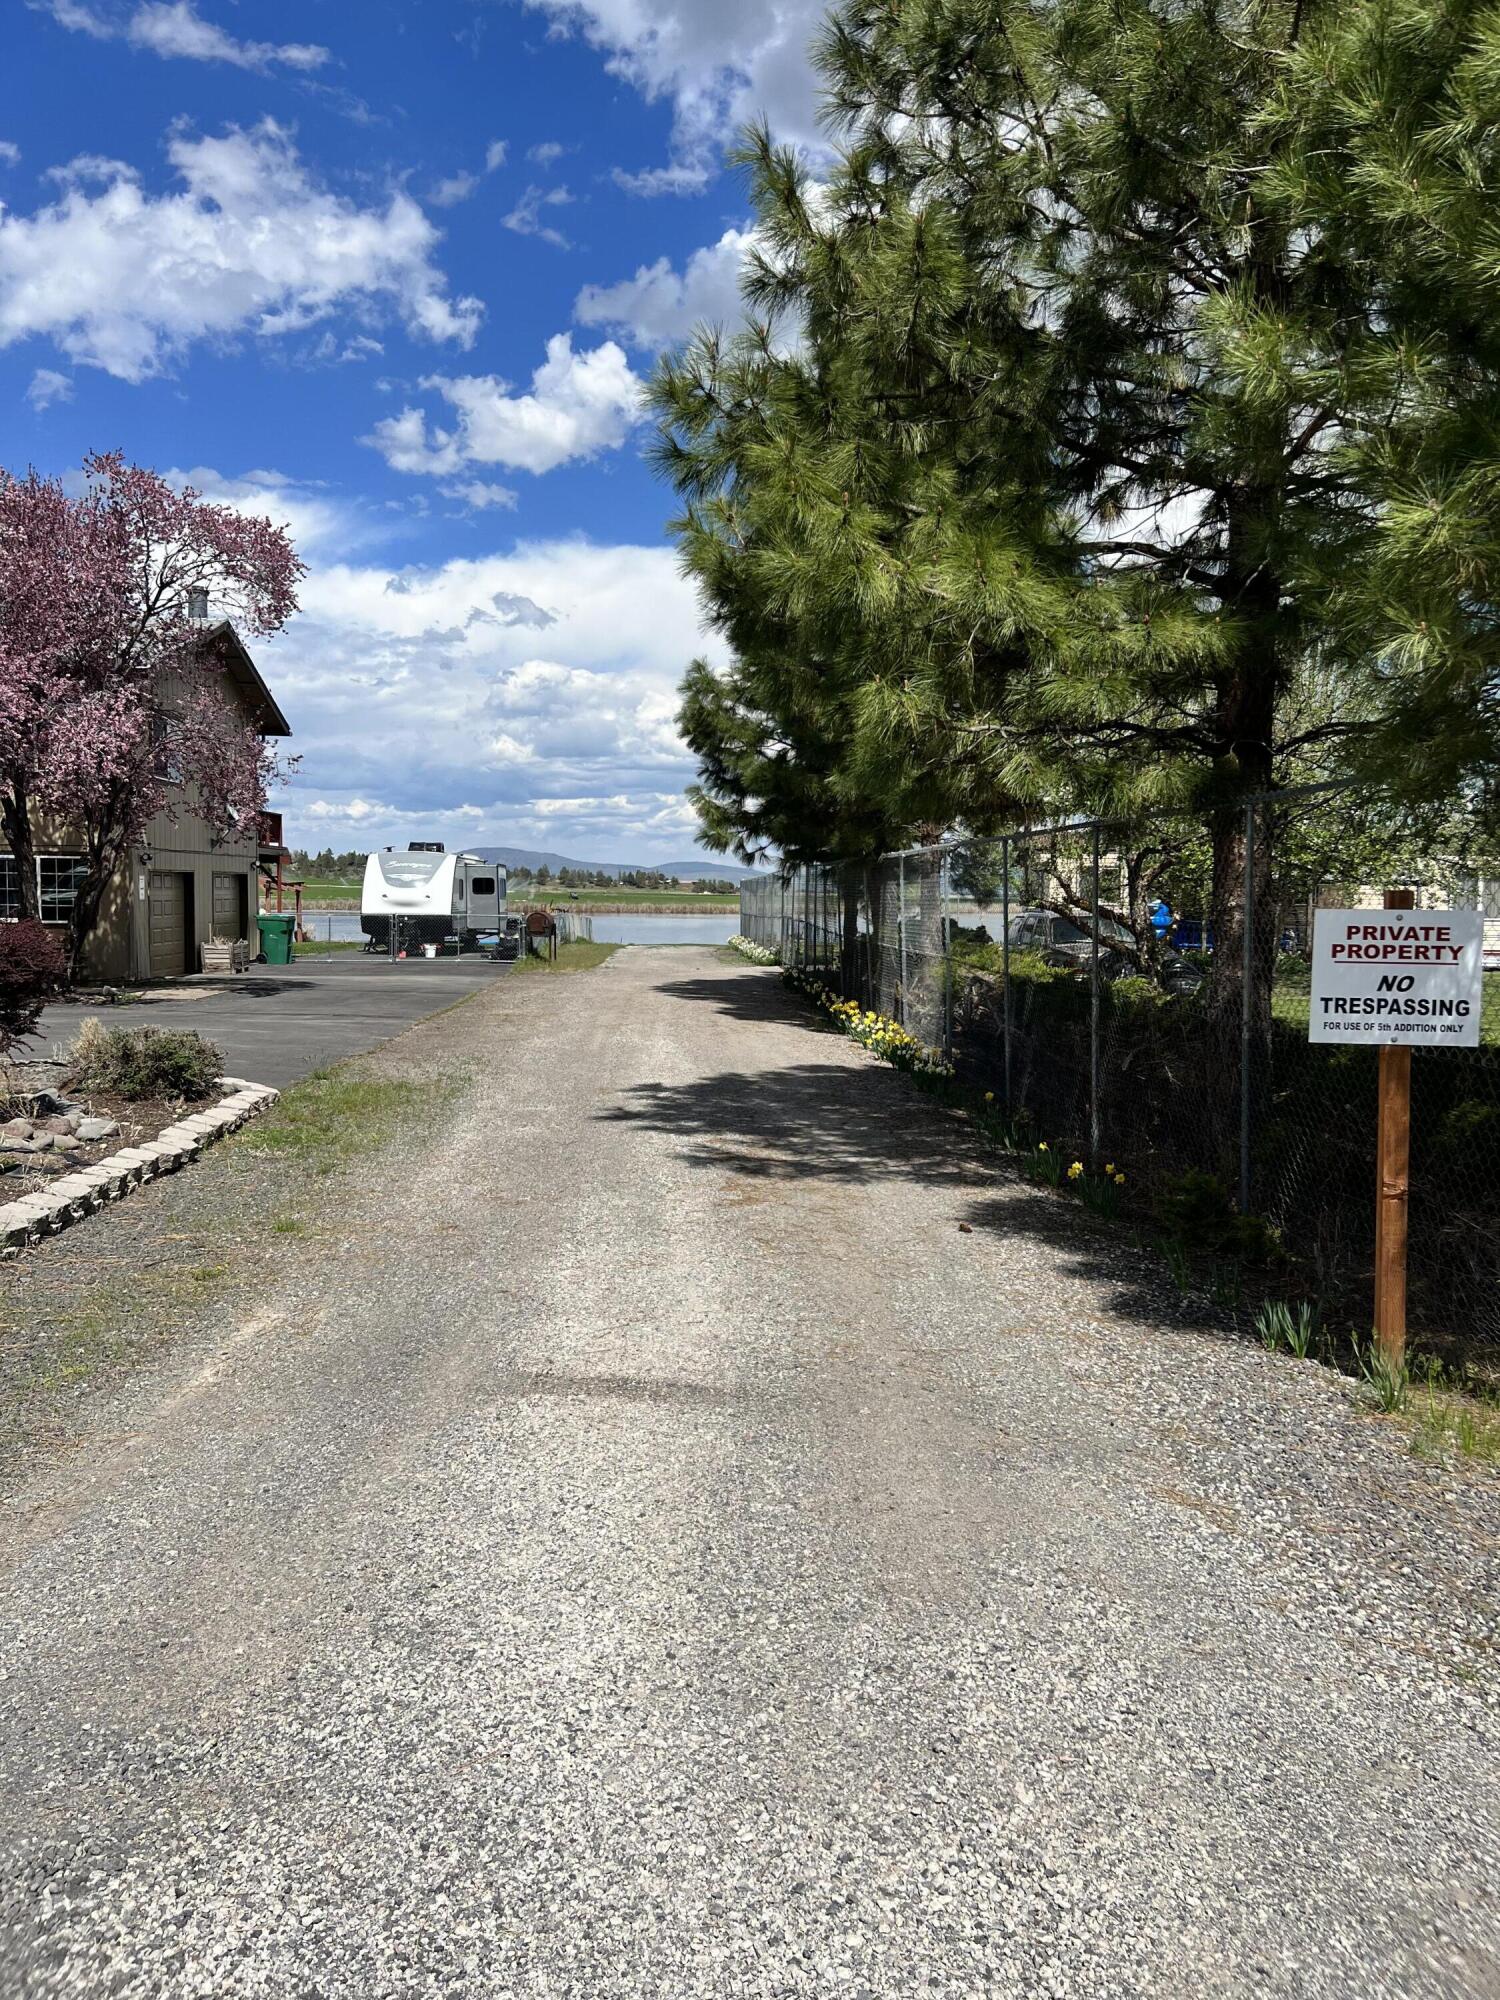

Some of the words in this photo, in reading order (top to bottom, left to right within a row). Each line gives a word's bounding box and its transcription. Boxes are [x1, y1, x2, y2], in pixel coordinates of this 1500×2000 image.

[1346, 925, 1451, 942] PRIVATE
[1331, 943, 1464, 961] PROPERTY
[1376, 975, 1415, 992] NO
[1320, 997, 1470, 1017] TRESPASSING
[1323, 1021, 1341, 1031] FOR
[1343, 1021, 1361, 1031] USE
[1363, 1022, 1375, 1031] OF
[1377, 1022, 1391, 1032] 5th
[1393, 1023, 1437, 1033] ADDITION
[1439, 1023, 1464, 1033] ONLY
